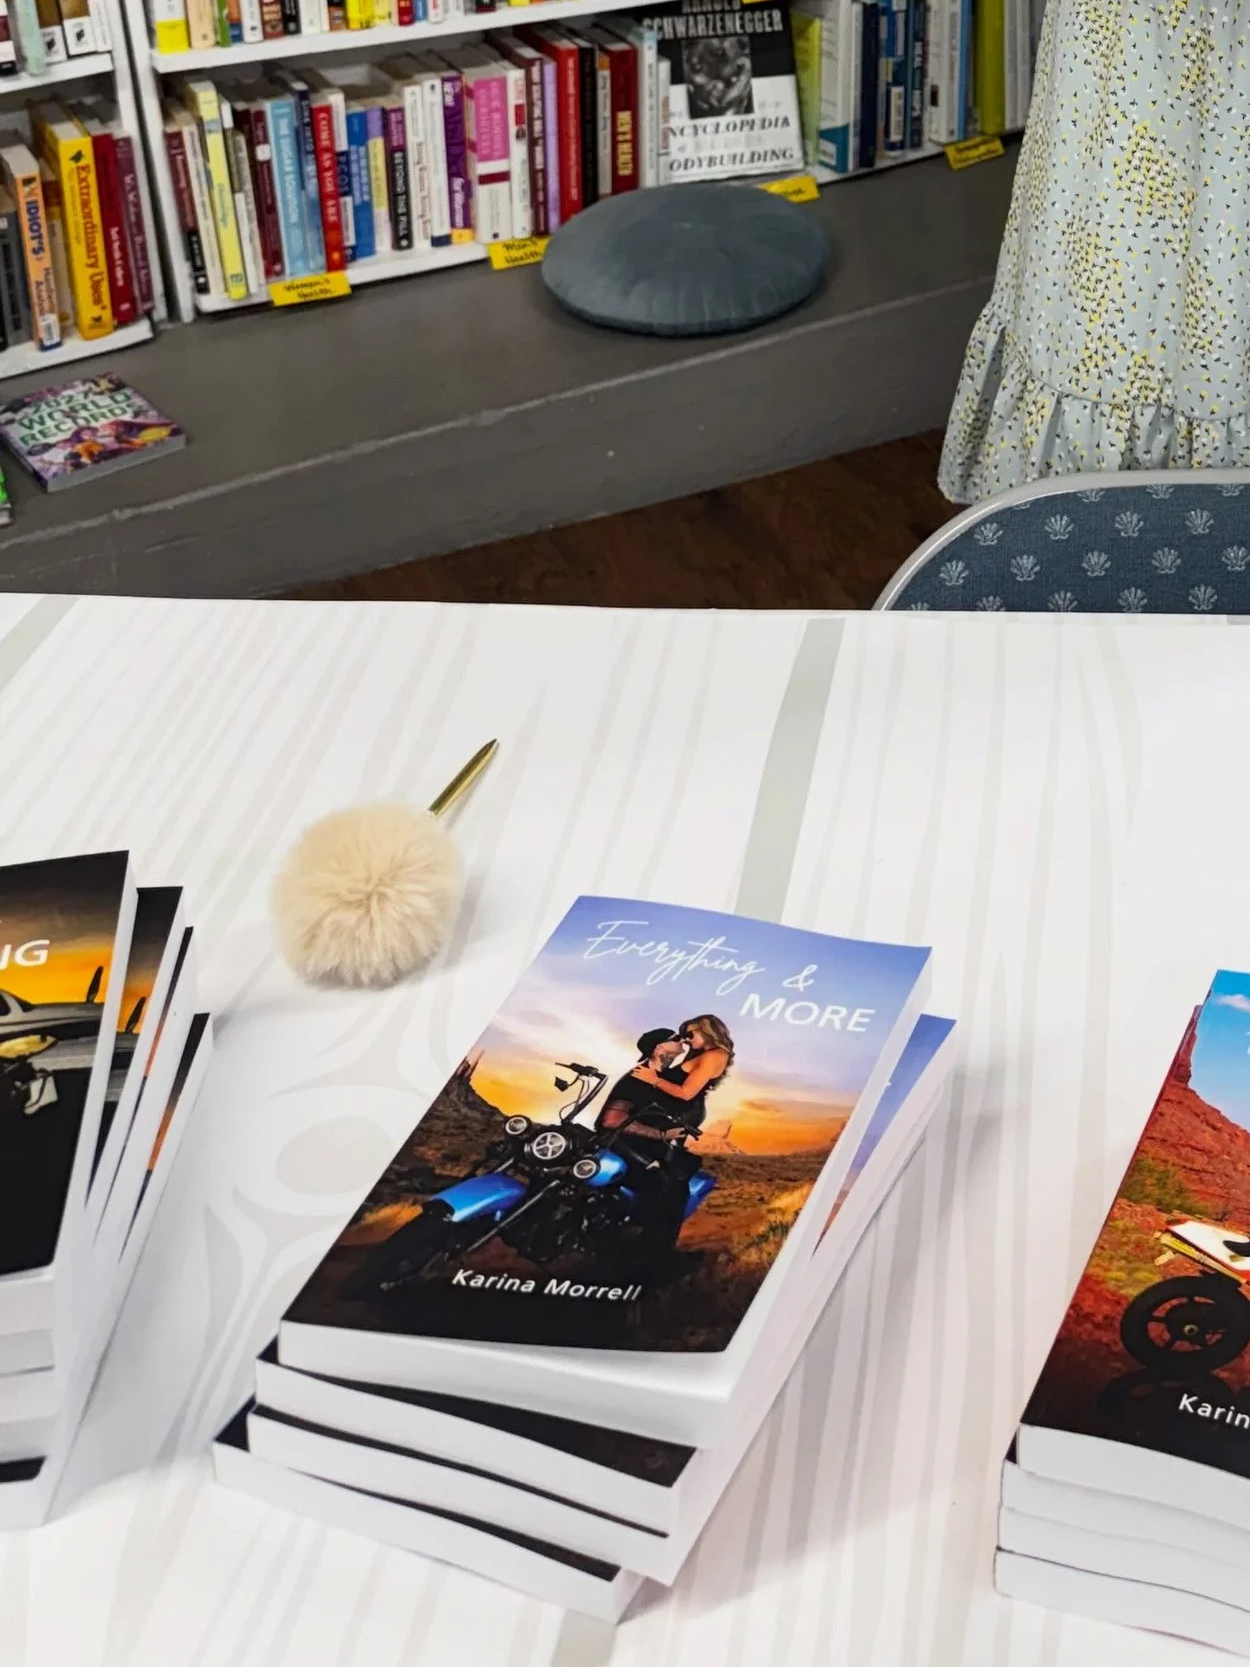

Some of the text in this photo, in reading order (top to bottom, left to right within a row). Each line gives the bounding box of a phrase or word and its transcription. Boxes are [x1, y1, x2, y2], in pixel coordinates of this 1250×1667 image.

[642, 9, 783, 40] SCHWARZENEGGER
[670, 116, 790, 138] NCYCLOPEDIA
[669, 148, 794, 172] ODYBUILDING
[76, 164, 99, 269] Extraordinary
[19, 392, 132, 433] WORLD
[21, 403, 143, 448] RECORDS
[582, 919, 819, 997] Everything &
[739, 992, 877, 1034] MORE
[451, 1266, 642, 1303] Karina Morrell
